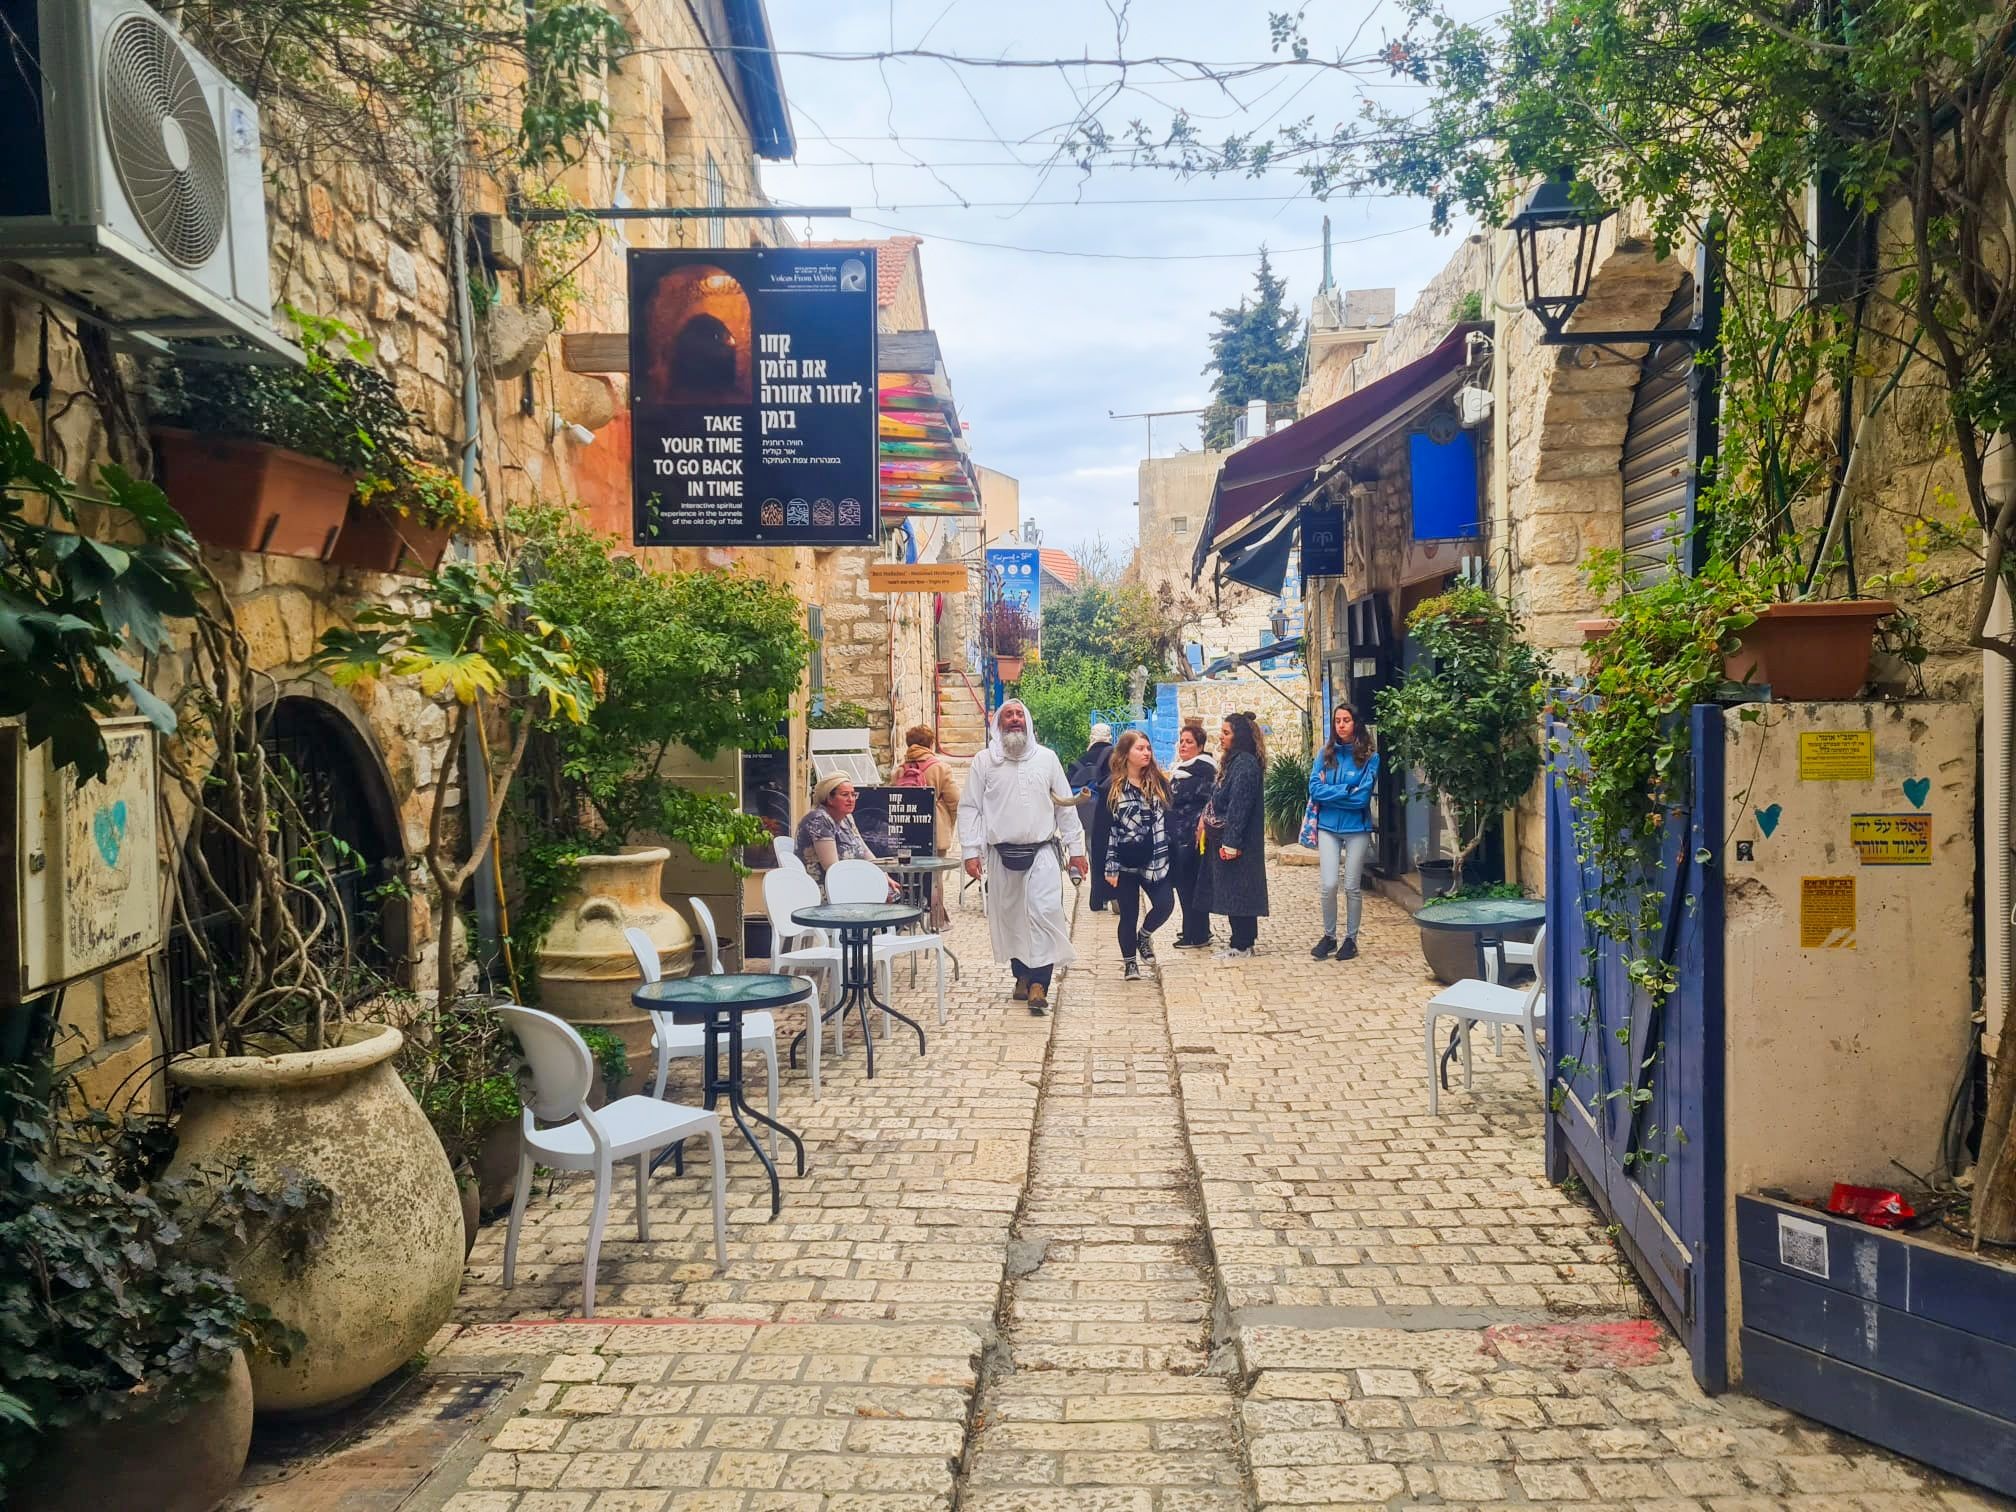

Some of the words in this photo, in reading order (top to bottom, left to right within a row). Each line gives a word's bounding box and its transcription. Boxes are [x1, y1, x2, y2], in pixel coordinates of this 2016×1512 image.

[794, 274, 812, 282] From
[760, 334, 791, 358] קחו
[760, 360, 797, 384] הזמן
[802, 360, 827, 378] את
[760, 385, 812, 403] אחורה
[817, 381, 862, 403] לחזור
[704, 416, 743, 432] TAKE
[760, 410, 796, 435] בזמן
[661, 437, 704, 454] YOUR
[706, 437, 743, 454] TIME
[653, 459, 674, 475] TO
[676, 459, 699, 475] GO
[702, 459, 743, 475] BACK
[687, 480, 704, 496] IN
[706, 480, 743, 496] TIME
[716, 502, 742, 510] spiritual
[660, 510, 697, 518] experience
[705, 518, 717, 526] city
[889, 793, 903, 804] קחו
[889, 805, 905, 814] הזמן
[889, 815, 911, 823] אחורה
[912, 814, 932, 823] לחזור
[1874, 819, 1892, 833] על
[888, 825, 903, 836] בזמן
[1854, 822, 1871, 832] ידי
[1892, 837, 1928, 854] לימוד
